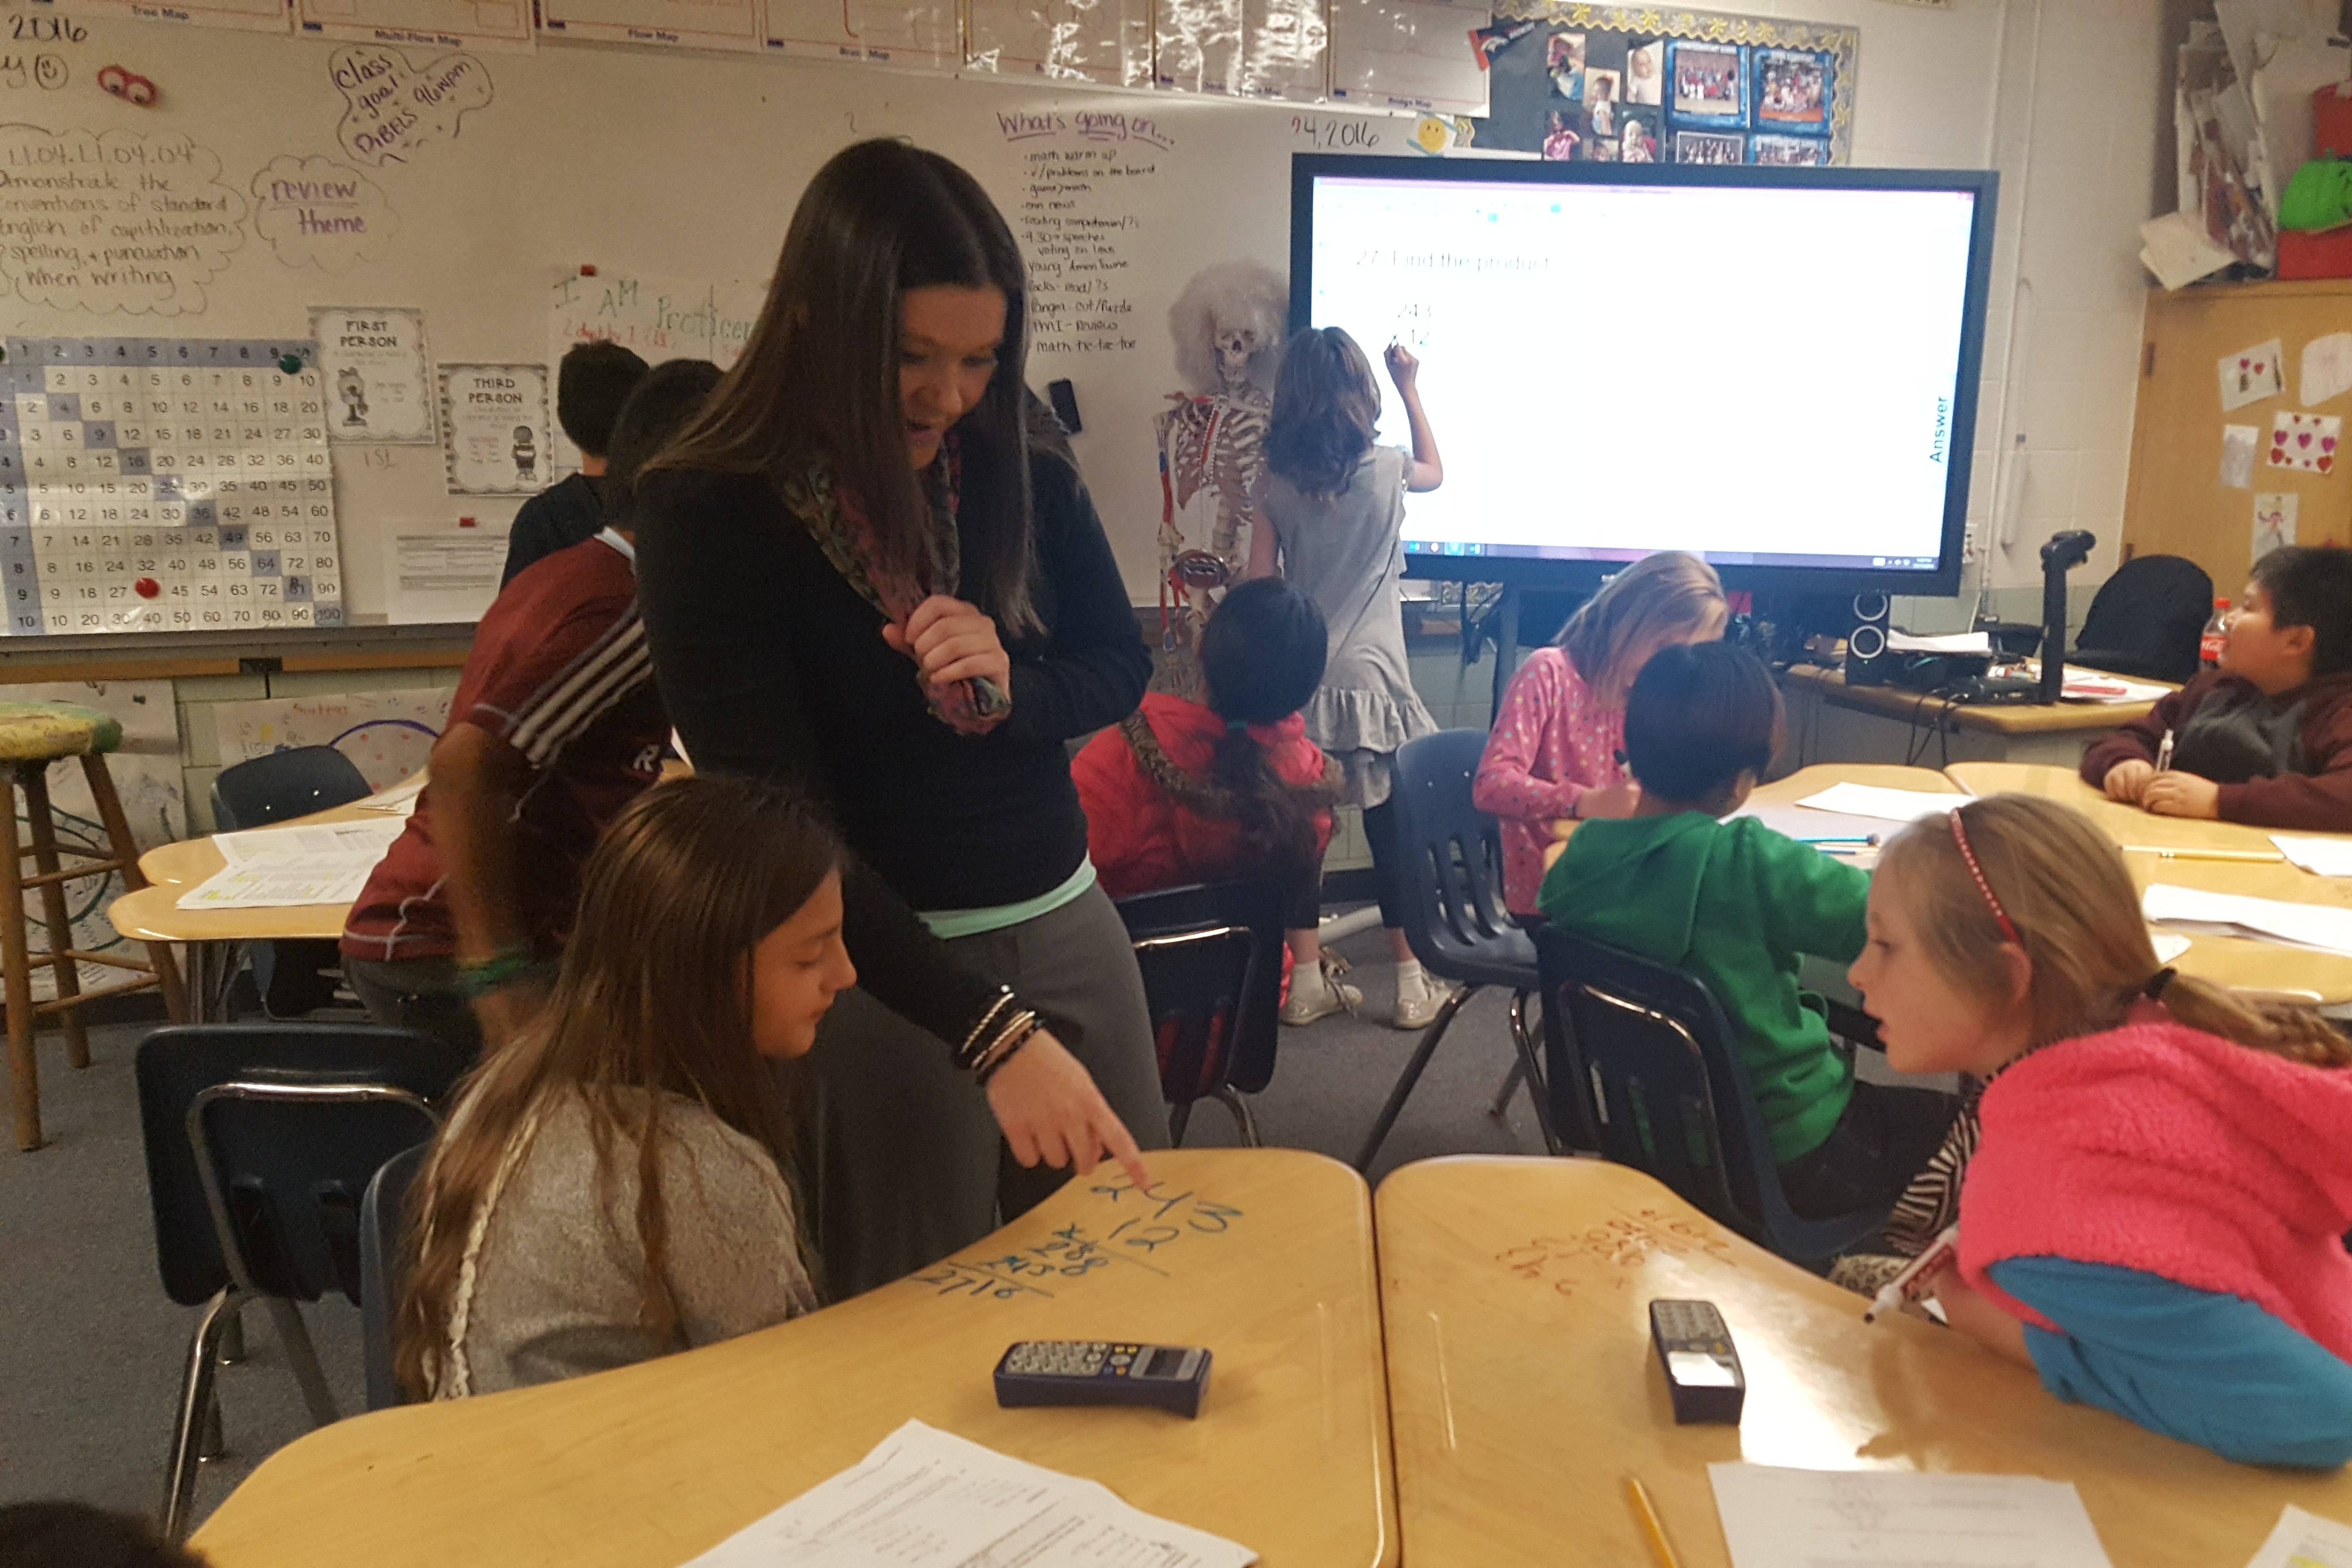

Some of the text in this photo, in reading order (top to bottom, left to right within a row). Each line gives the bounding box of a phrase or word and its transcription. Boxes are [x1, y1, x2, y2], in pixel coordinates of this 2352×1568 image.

[162, 8, 189, 20] Map
[438, 35, 462, 47] Map
[657, 32, 678, 42] Map
[869, 49, 890, 60] Map
[335, 55, 392, 89] Class
[358, 75, 398, 119] goal
[1415, 99, 1431, 108] Map
[997, 112, 1066, 135] What's
[1076, 112, 1127, 140] going
[1326, 121, 1380, 149] 2016
[141, 172, 170, 191] the
[271, 180, 357, 201] review
[118, 192, 141, 212] of
[298, 208, 367, 236] theme
[1441, 253, 1470, 268] the
[91, 265, 176, 302] writing
[1397, 303, 1431, 318] 243
[346, 320, 388, 333] FIRST
[340, 336, 397, 348] PERSON
[473, 378, 516, 389] THIRD
[468, 393, 523, 404] PERSON
[27, 401, 318, 414] 2 6 8 10 12 14 16 18 20
[31, 427, 321, 441] 3 6 12 15 18 21 24 27 30
[1930, 396, 1948, 463] Answer
[34, 454, 324, 468] 4 12 20 24 28 32 36 40
[100, 480, 325, 493] 15 35 40 45 50
[69, 505, 328, 520] 12 18 24 30 42 48 54 60
[72, 531, 330, 547] 14 21 28 35 42 56 63 70
[76, 557, 333, 573] 16 24 32 40 48 56 64 72 80
[79, 583, 335, 598] 18 27 45 54 63 72 90
[51, 609, 308, 626] 10 20 50 60 70 80 90
